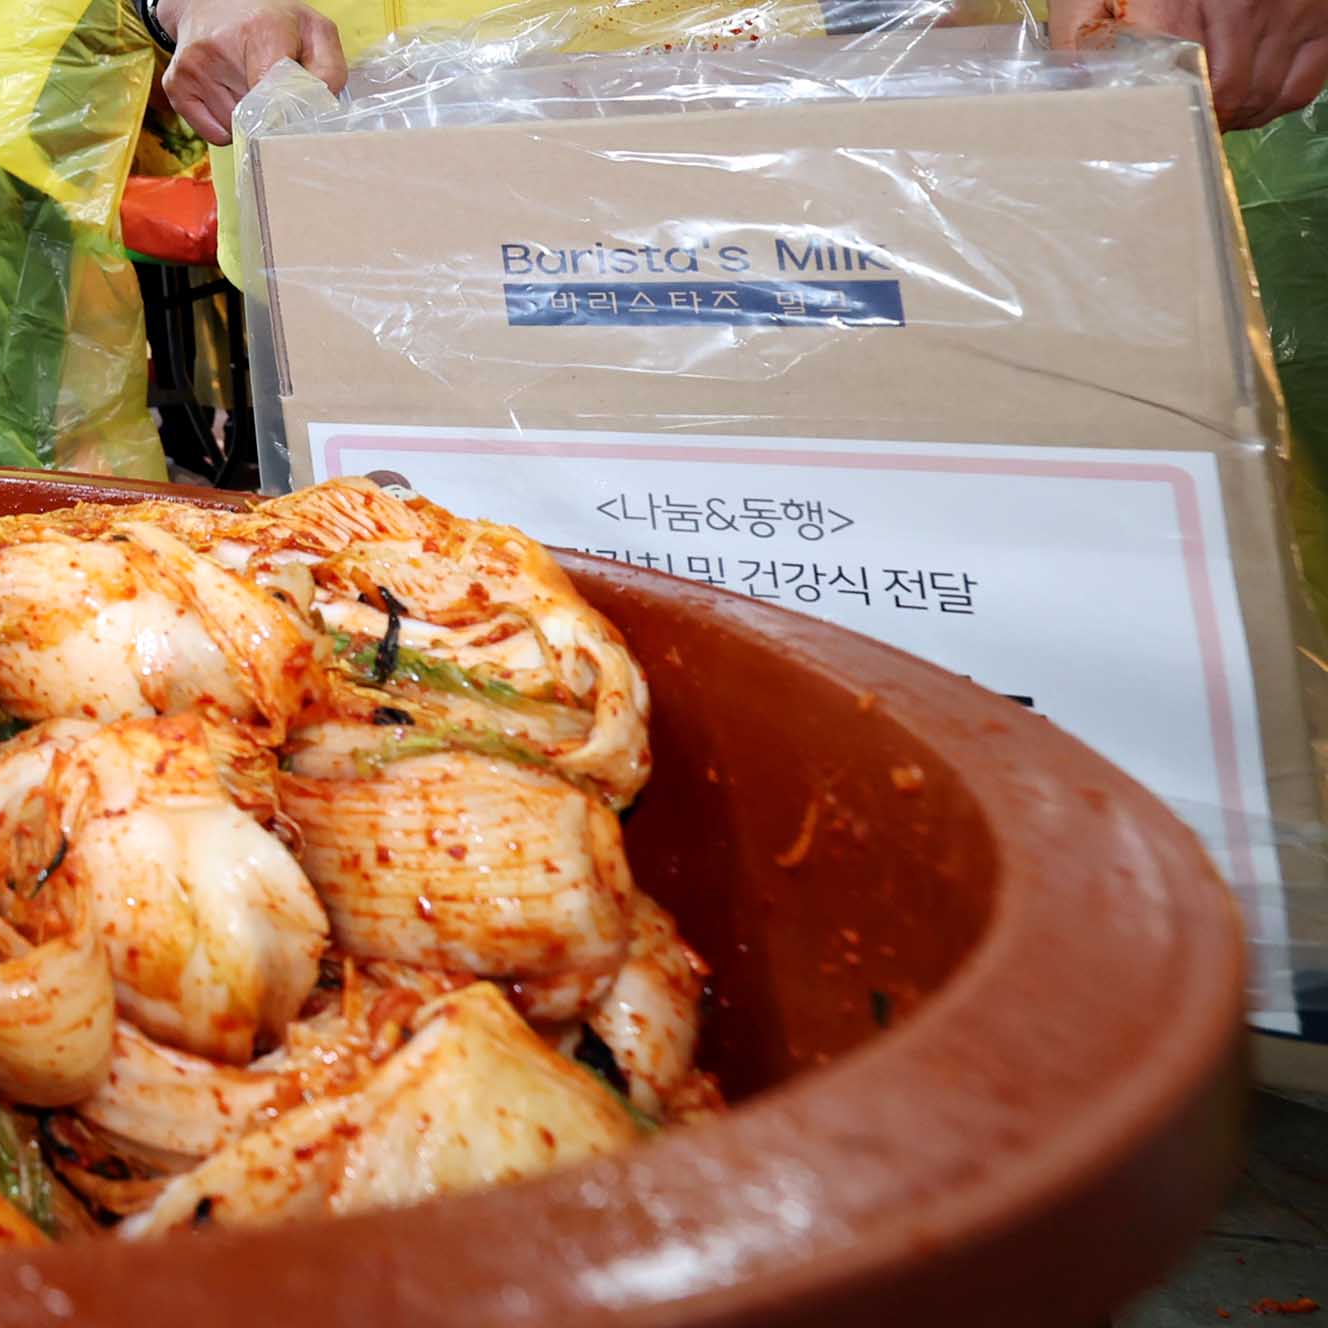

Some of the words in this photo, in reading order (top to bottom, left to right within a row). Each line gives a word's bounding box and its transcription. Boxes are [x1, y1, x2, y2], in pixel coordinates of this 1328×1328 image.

[501, 238, 750, 274] Barista's
[550, 289, 743, 315] 바리스타즈
[595, 492, 855, 541] <나눔&동행>
[738, 559, 872, 606] 건강식
[883, 566, 979, 615] 전달
